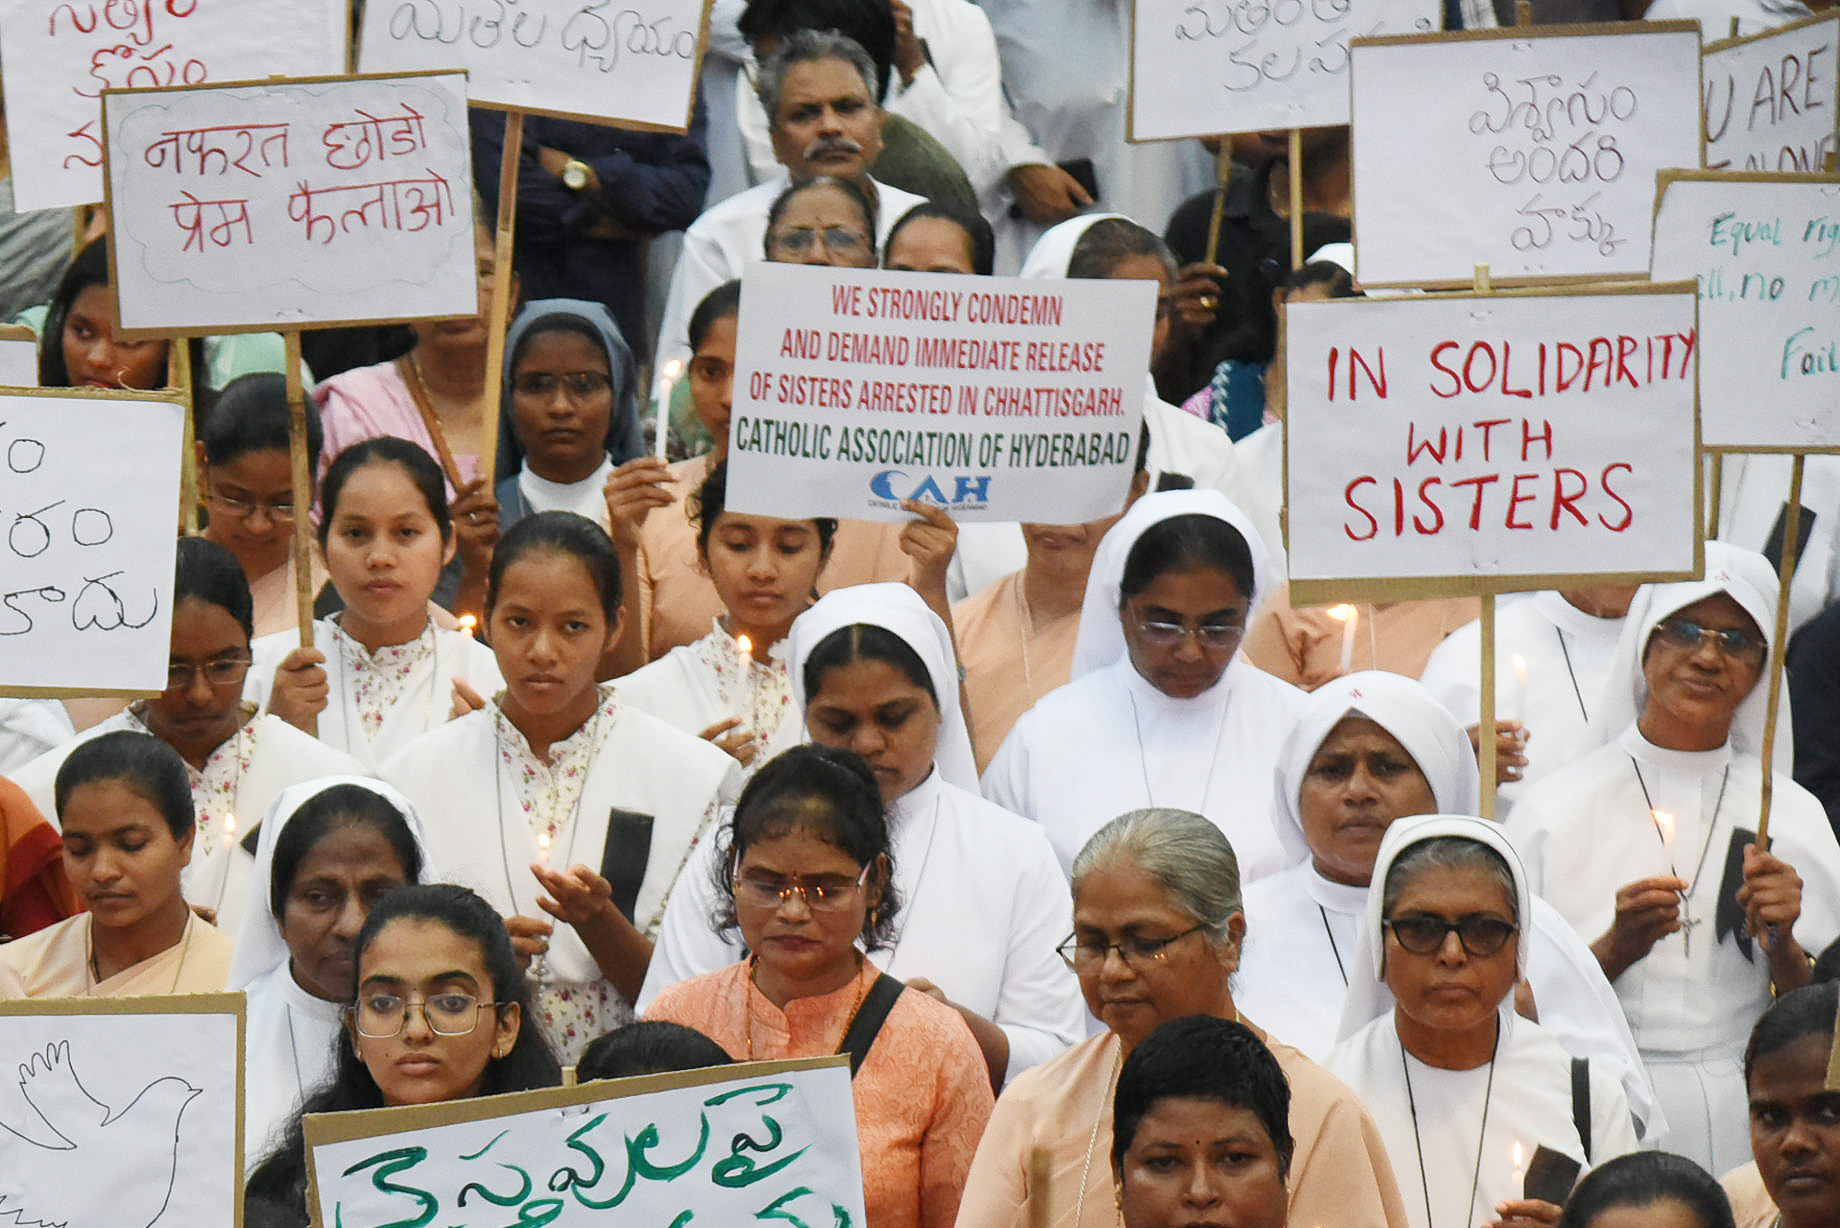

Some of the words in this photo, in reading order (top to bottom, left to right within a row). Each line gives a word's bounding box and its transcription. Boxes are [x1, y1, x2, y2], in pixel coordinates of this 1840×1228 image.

[1748, 43, 1829, 131] ARE
[168, 189, 255, 253] प्रेम
[1710, 211, 1781, 257] Equal
[831, 283, 861, 316] WE
[866, 287, 961, 322] STRONGLY
[967, 291, 1064, 326] CONDEMN
[780, 327, 821, 361] AND
[827, 331, 910, 367] DEMAND
[915, 336, 1021, 371] IMMEDIATE
[1025, 341, 1106, 373] RELEASE
[1327, 345, 1389, 402] IN
[1429, 327, 1696, 398] SOLIDARITY
[750, 371, 773, 401] OF
[777, 373, 853, 410] SISTERS
[858, 379, 952, 415] ARRESTED
[957, 385, 979, 416] IN
[983, 386, 1126, 418] CHHATTISGARH.
[736, 415, 831, 460] CATHOLIC
[837, 424, 972, 468] ASSOCIATION
[978, 430, 1005, 468] OF
[1009, 431, 1131, 469] HYDERABAD
[1406, 417, 1553, 466] WITH
[1343, 461, 1635, 541] SISTERS
